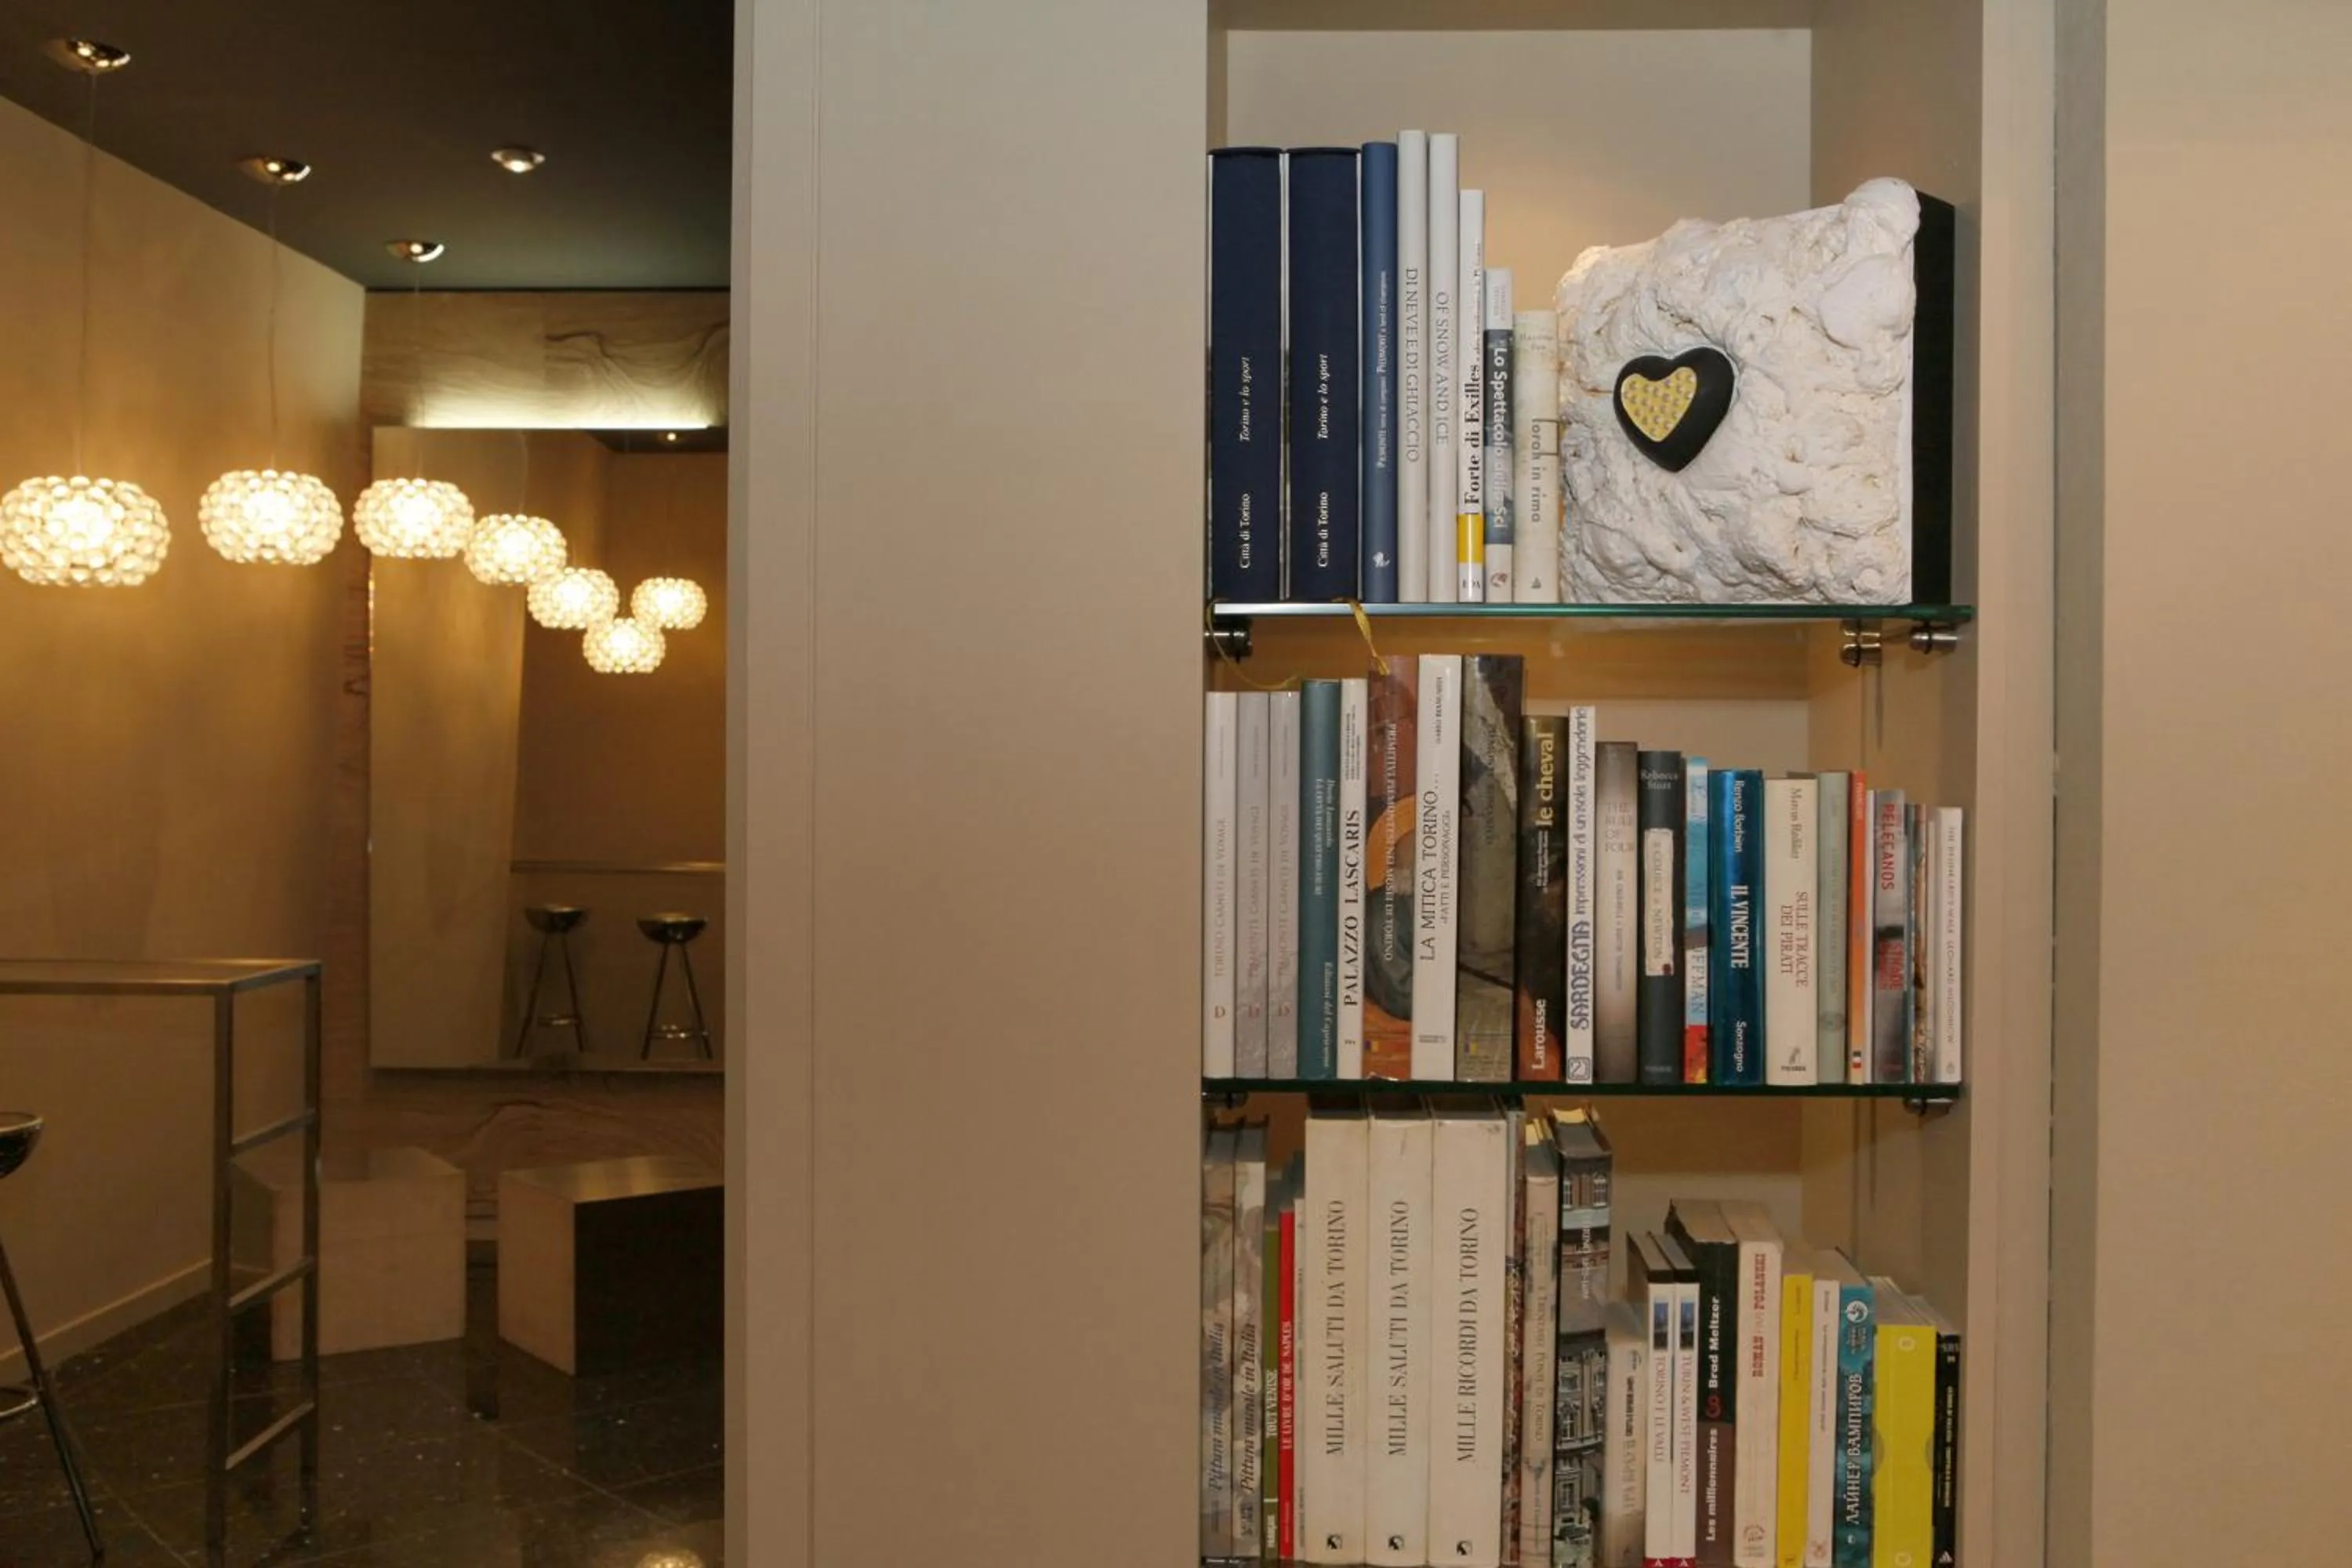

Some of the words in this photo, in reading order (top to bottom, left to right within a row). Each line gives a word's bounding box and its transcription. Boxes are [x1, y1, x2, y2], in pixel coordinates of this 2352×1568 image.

[1406, 268, 1419, 285] DI
[1406, 287, 1419, 334] NEVE
[1436, 290, 1449, 314] OF
[1406, 339, 1419, 350] E
[1406, 352, 1419, 369] DI
[1436, 318, 1449, 370] SNOW
[1494, 347, 1508, 366] Lo
[1239, 356, 1252, 383] sport
[1317, 353, 1330, 381] sport
[1239, 384, 1250, 397] lo
[1317, 383, 1328, 394] lo
[1436, 372, 1449, 412] AND
[1464, 363, 1480, 423] Exilles
[1239, 408, 1252, 441] Torino
[1317, 405, 1330, 439] Torino
[1406, 373, 1419, 462] GHIACCIO
[1436, 416, 1449, 445] ICE
[1490, 370, 1508, 456] Spettacolo
[1464, 430, 1480, 448] di
[1464, 454, 1480, 505] Forte
[1532, 466, 1547, 481] in
[1239, 492, 1250, 528] Torino
[1317, 491, 1328, 525] Torino
[1494, 506, 1508, 528] Sci
[1532, 485, 1548, 523] rima
[1239, 530, 1250, 540] di
[1317, 528, 1328, 539] di
[1534, 731, 1555, 801] cheval
[1534, 807, 1553, 826] le
[1344, 809, 1359, 904] LASCARIS
[1882, 803, 1895, 891] PELECANOS
[1385, 867, 1394, 901] MUSEI
[1420, 867, 1436, 929] MITICA
[1730, 884, 1749, 898] IL
[1385, 903, 1394, 915] DI
[1781, 904, 1794, 927] DEI
[1795, 890, 1808, 931] SULLE
[1385, 918, 1394, 960] TORINO
[1419, 936, 1436, 960] LA
[1653, 907, 1663, 959] NEWTON
[1730, 900, 1749, 969] VINCENTE
[1781, 931, 1794, 974] PIRATI
[1343, 915, 1358, 1006] PALAZZO
[1570, 920, 1590, 1030] SARDEGNA
[1795, 933, 1808, 988] TRACCE
[1532, 998, 1547, 1069] Larousse
[1733, 1020, 1747, 1073] Sonzogno
[1327, 1200, 1346, 1276] TORINO
[1389, 1200, 1409, 1276] TORINO
[1458, 1207, 1479, 1283] TORINO
[1327, 1281, 1345, 1308] DA
[1389, 1282, 1408, 1308] DA
[1458, 1287, 1478, 1313] DA
[1241, 1323, 1256, 1363] Italia
[1708, 1295, 1719, 1351] Meltzer
[1282, 1361, 1292, 1372] DE
[1326, 1316, 1345, 1387] SALUTI
[1389, 1316, 1408, 1388] SALUTI
[1457, 1319, 1477, 1396] RICORDI
[1708, 1353, 1719, 1389] Brad
[1242, 1366, 1254, 1382] in
[1654, 1355, 1667, 1403] TORINO
[1241, 1383, 1254, 1436] murale
[1265, 1411, 1278, 1438] TOUT
[1282, 1405, 1292, 1434] LIVRE
[1326, 1393, 1345, 1455] MILLE
[1388, 1394, 1407, 1455] MILLE
[1846, 1372, 1863, 1457] ВАМПИРОВ
[1282, 1436, 1292, 1449] LE
[1457, 1402, 1476, 1463] MILLE
[1207, 1438, 1224, 1490] Pittura
[1241, 1439, 1254, 1490] Pittura
[1706, 1427, 1718, 1515] millionnaires
[1843, 1461, 1861, 1525] ЛАЙНЕР
[1706, 1518, 1717, 1541] Les
